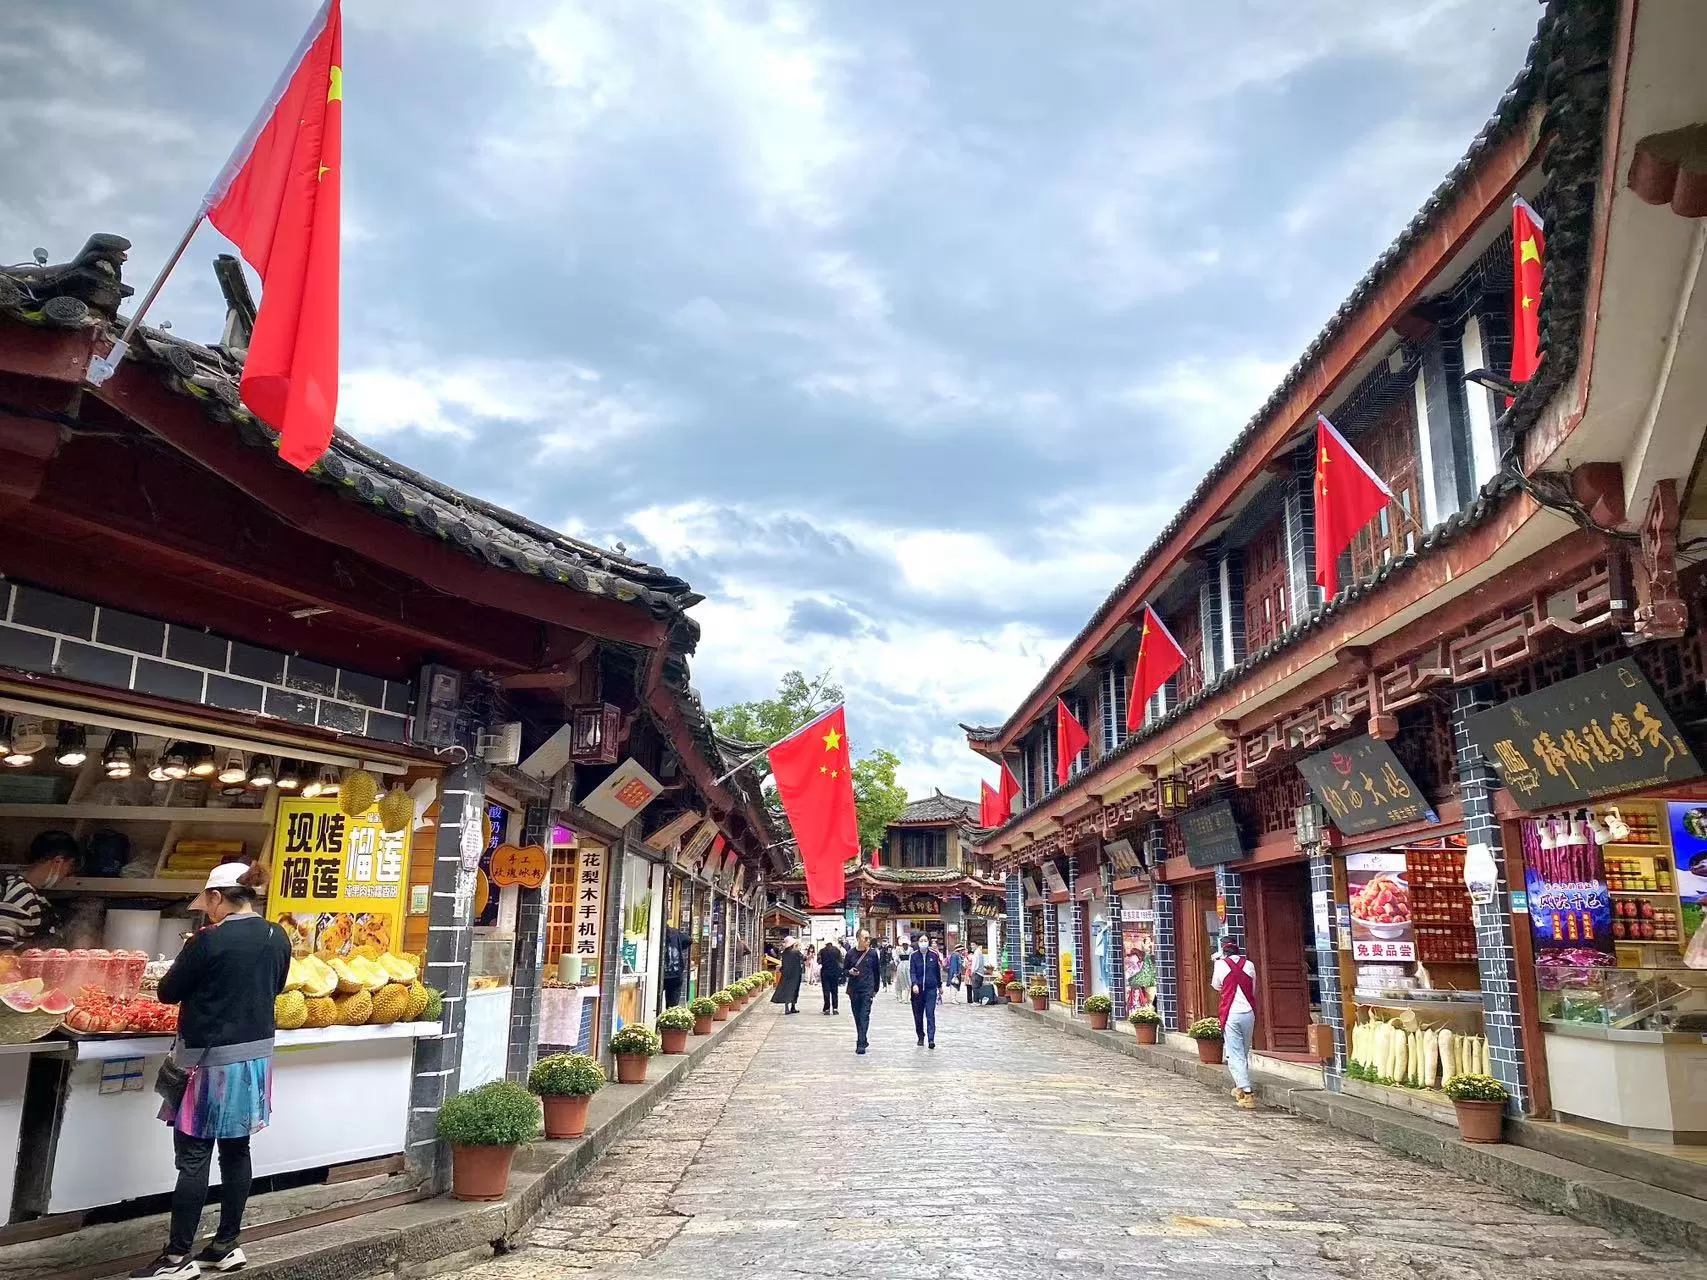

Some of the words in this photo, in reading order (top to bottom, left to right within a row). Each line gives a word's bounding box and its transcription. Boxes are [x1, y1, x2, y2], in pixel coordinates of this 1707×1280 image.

[285, 812, 345, 853] 现烤
[345, 826, 405, 882] 榴莲
[493, 867, 543, 880] 玫瑰冰粉
[509, 853, 530, 865] 手工
[280, 857, 341, 898] 榴莲
[577, 853, 600, 954] 花梨木手机壳
[1357, 944, 1412, 957] 免费品尝
